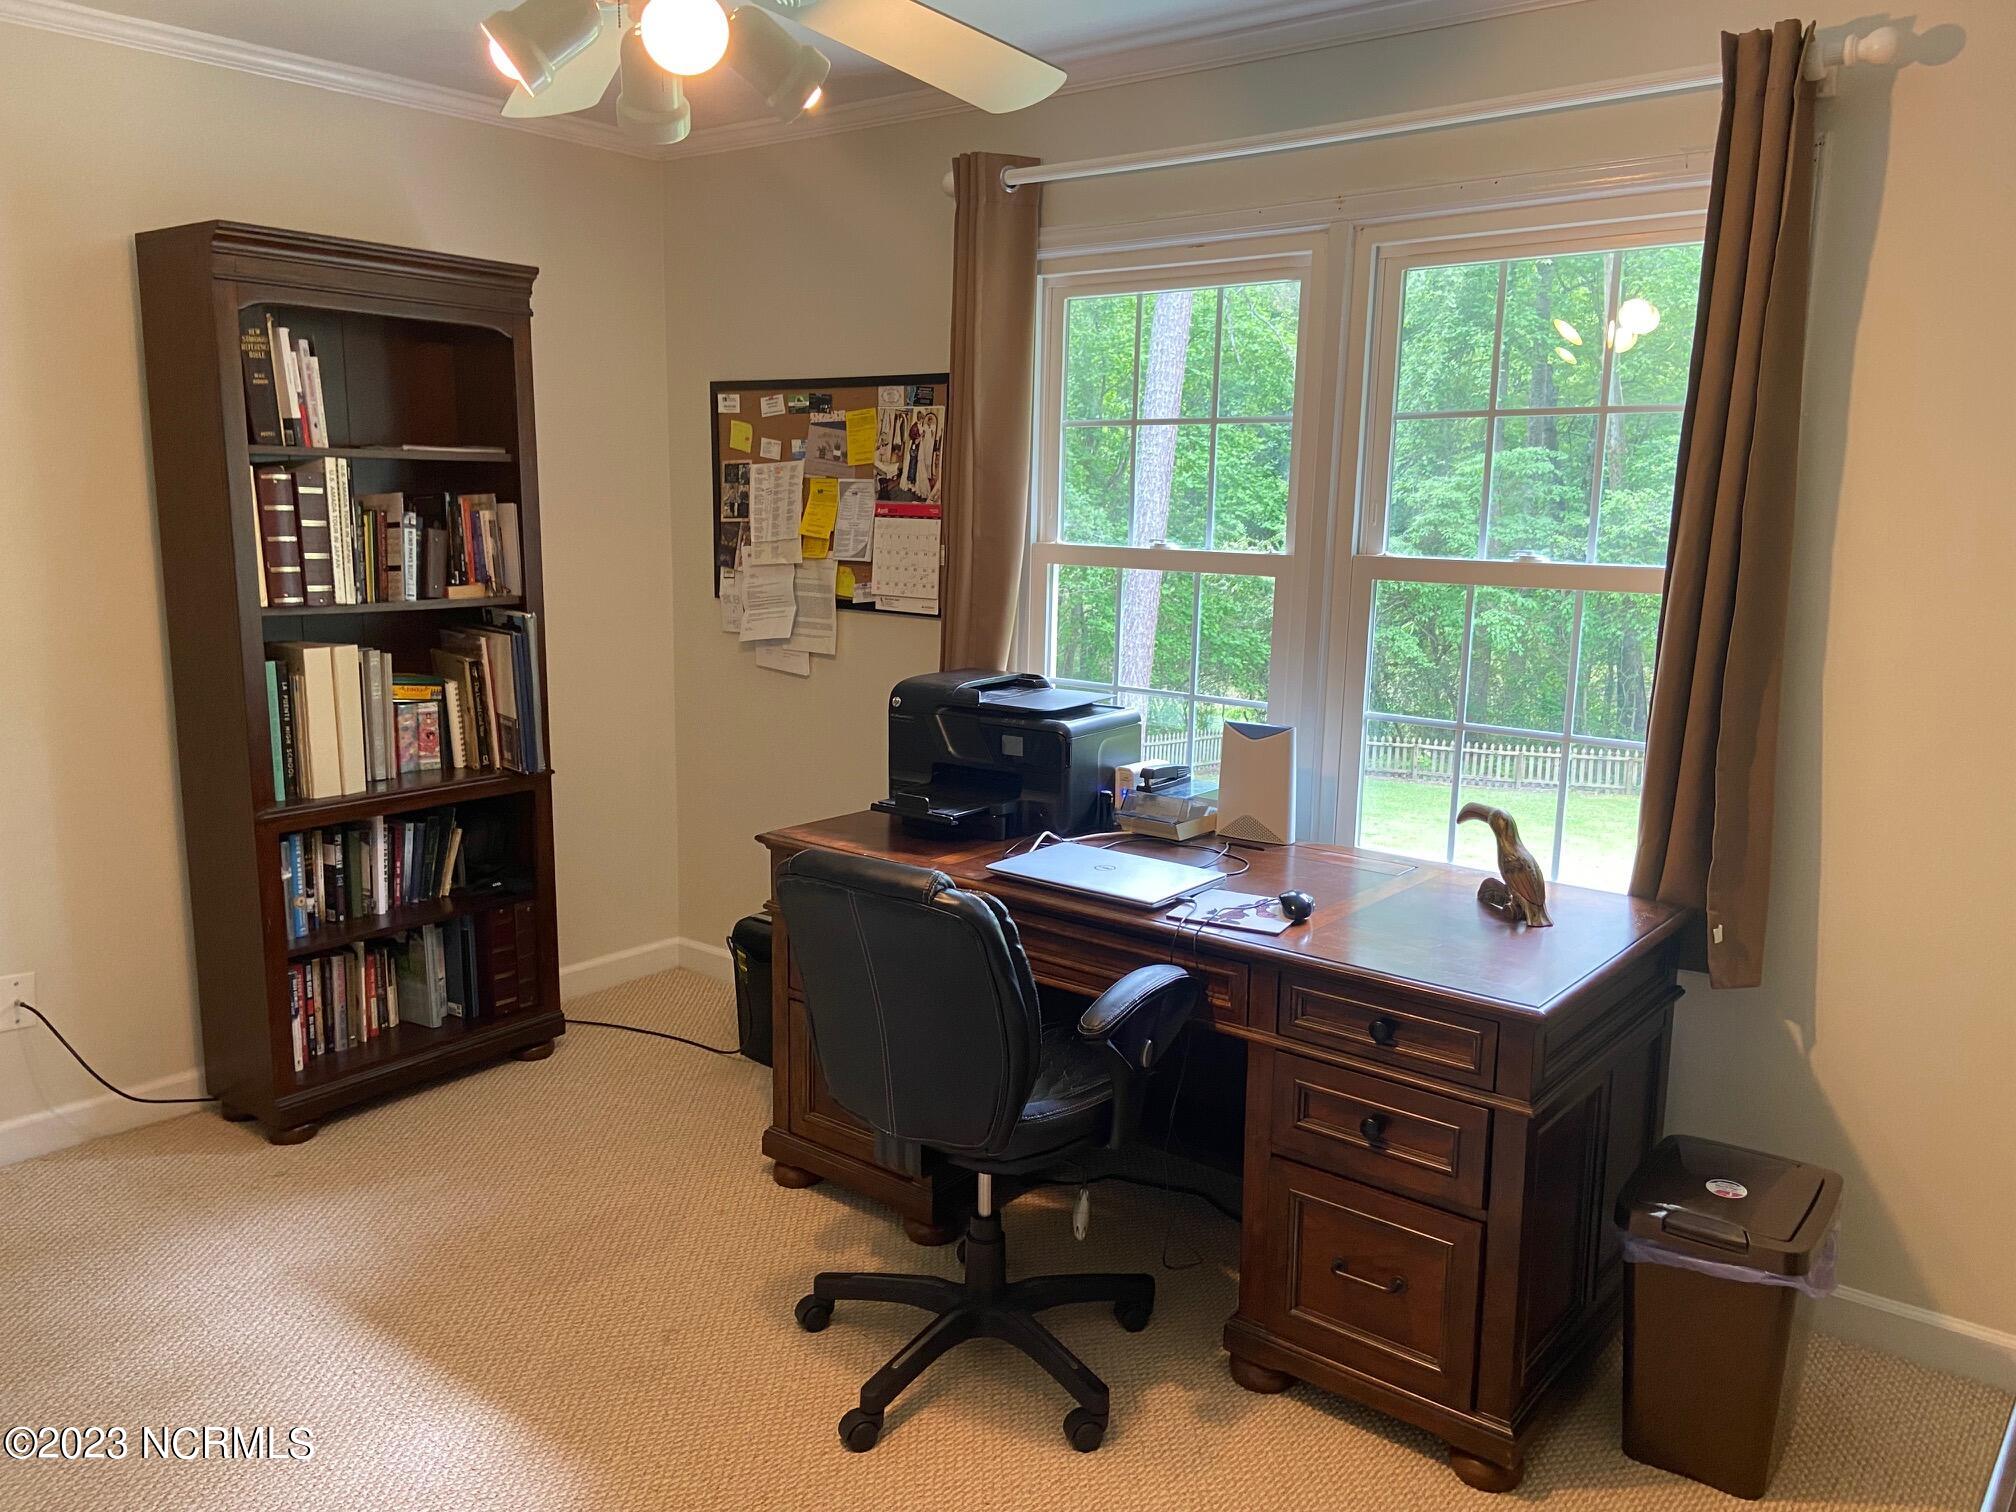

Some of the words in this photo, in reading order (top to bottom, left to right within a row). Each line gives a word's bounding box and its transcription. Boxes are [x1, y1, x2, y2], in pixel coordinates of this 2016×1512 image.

[333, 544, 341, 569] JAPAN
[281, 681, 288, 691] LA
[286, 748, 295, 778] SCHOOL
